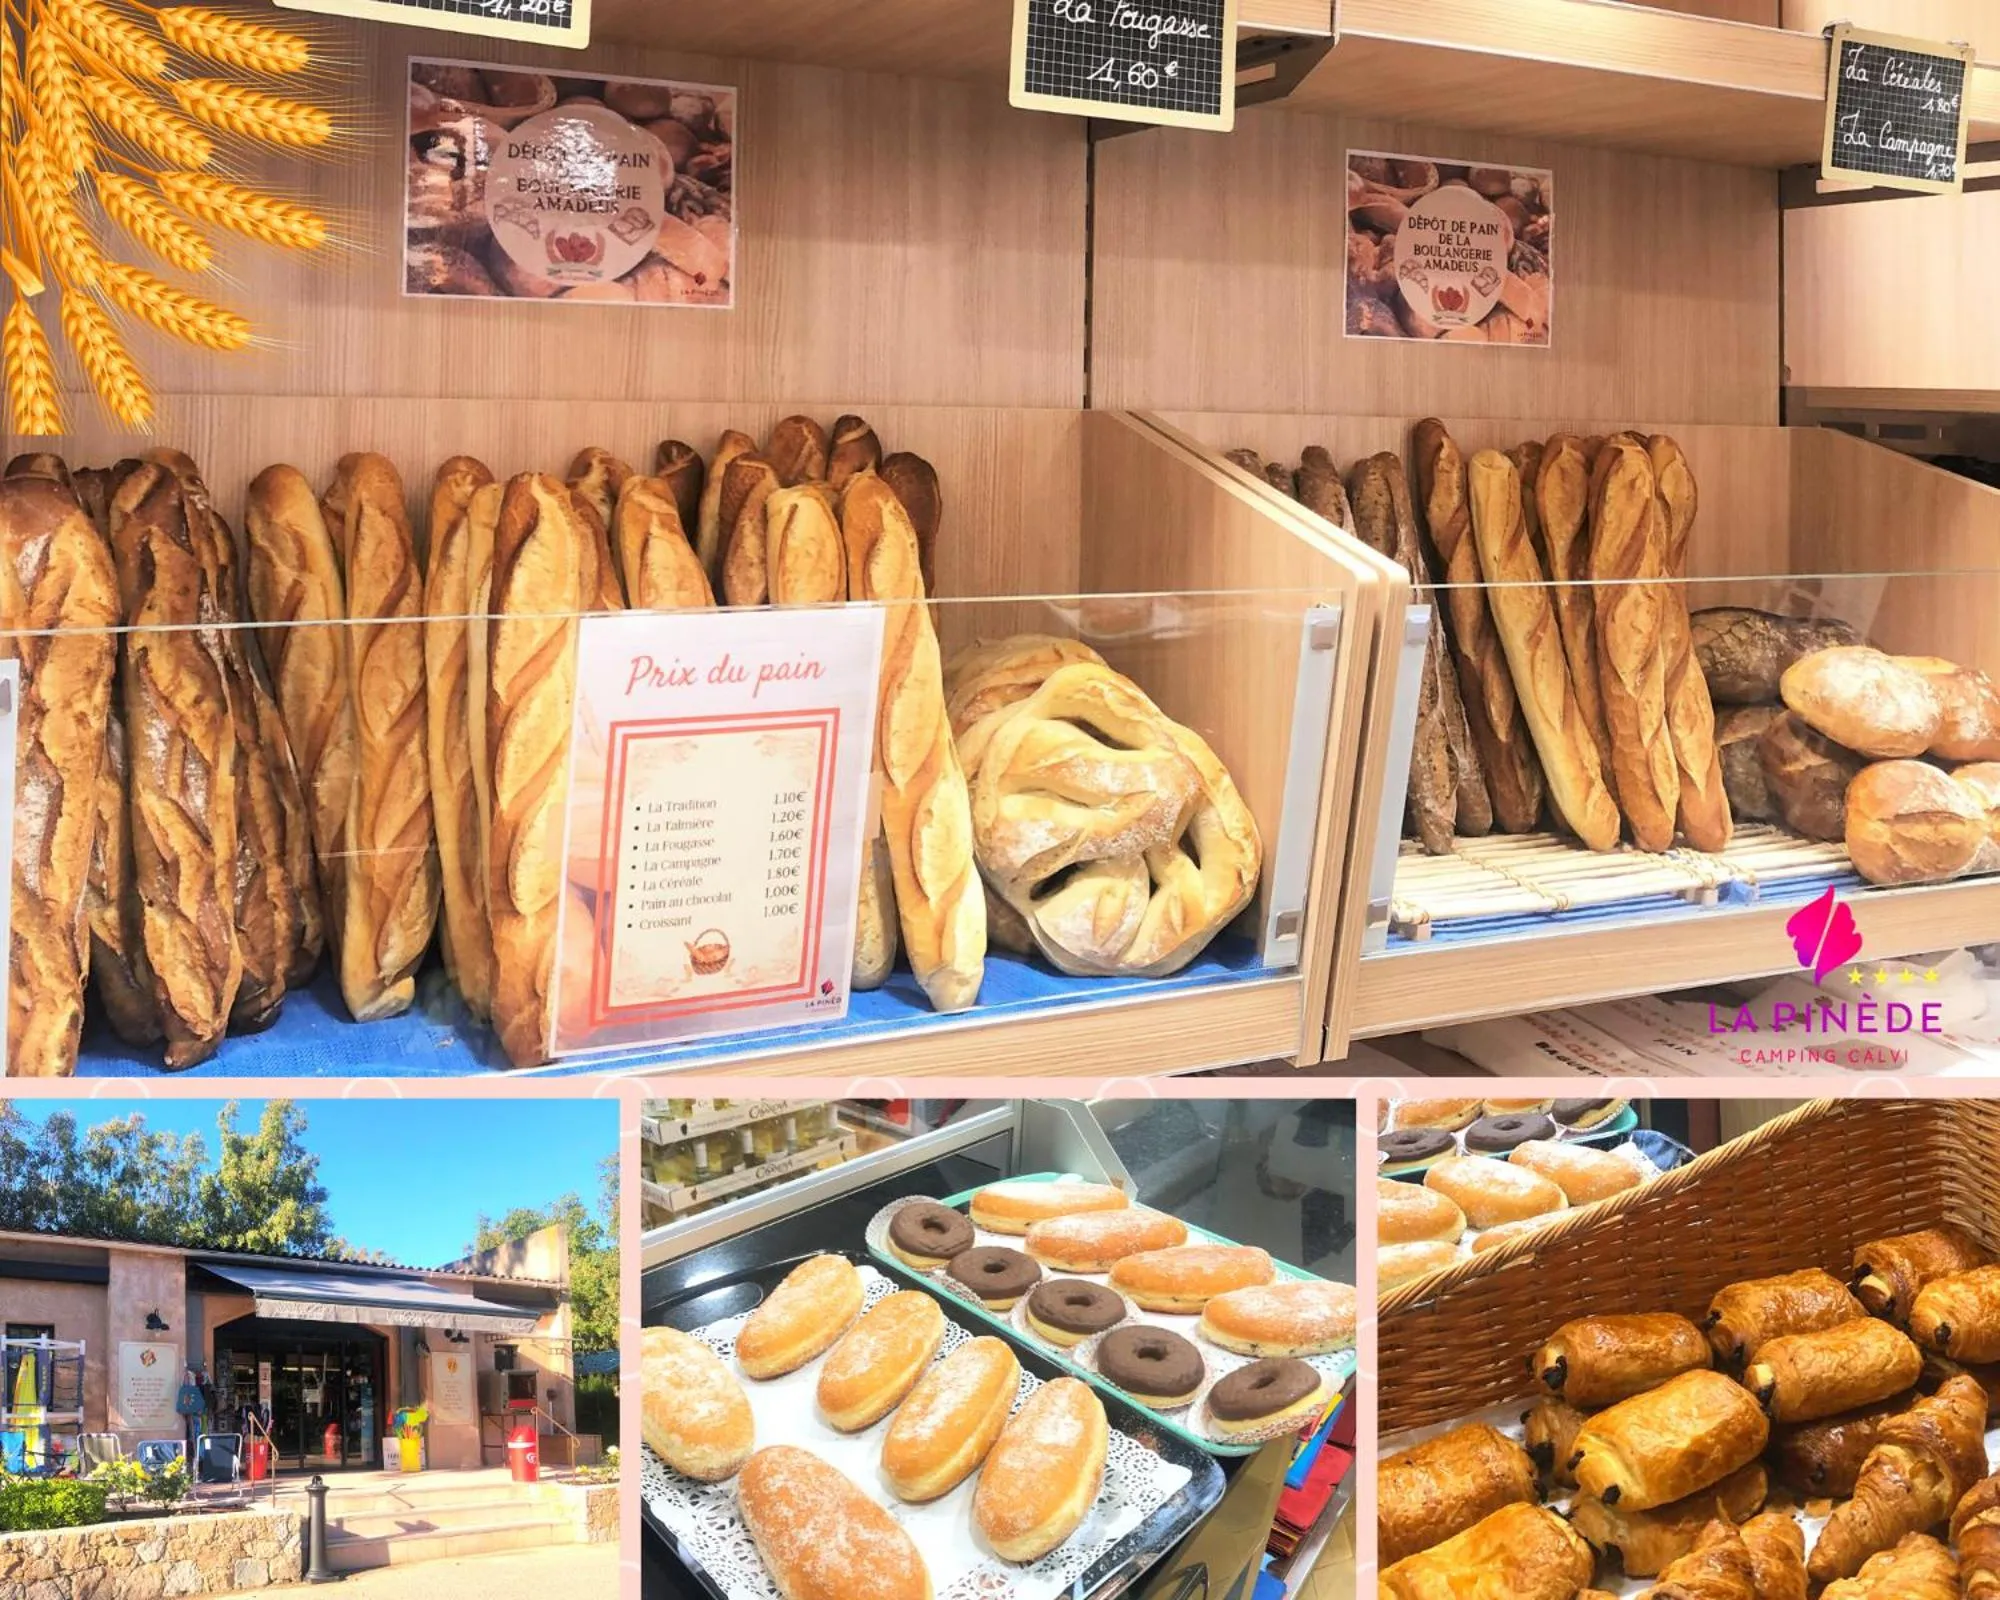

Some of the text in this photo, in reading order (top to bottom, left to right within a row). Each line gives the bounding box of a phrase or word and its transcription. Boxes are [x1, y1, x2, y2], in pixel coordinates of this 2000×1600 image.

[1846, 45, 1869, 82] La
[1840, 110, 1956, 165] La Campagne
[533, 196, 620, 214] AMADEUS
[1439, 233, 1471, 246] DE LA
[1451, 220, 1467, 233] DE
[1470, 222, 1499, 235] PAIN
[1414, 243, 1493, 261] BOULANGERIE
[1424, 259, 1479, 273] AMADEUS
[624, 652, 827, 699] Prix du pain
[648, 791, 807, 813] La Tradition 1.10€
[647, 822, 661, 832] La
[772, 810, 805, 823] 1.20€
[645, 828, 804, 852] La Fougasse 1.60€
[643, 847, 802, 872] La Campagne 1.70€
[642, 880, 656, 891] La
[767, 866, 800, 880] 1.80€
[640, 884, 800, 911] Pain au chocolat 1.00€
[639, 903, 799, 930] Croissant 1.00€
[1535, 1041, 1609, 1077] BAGUET
